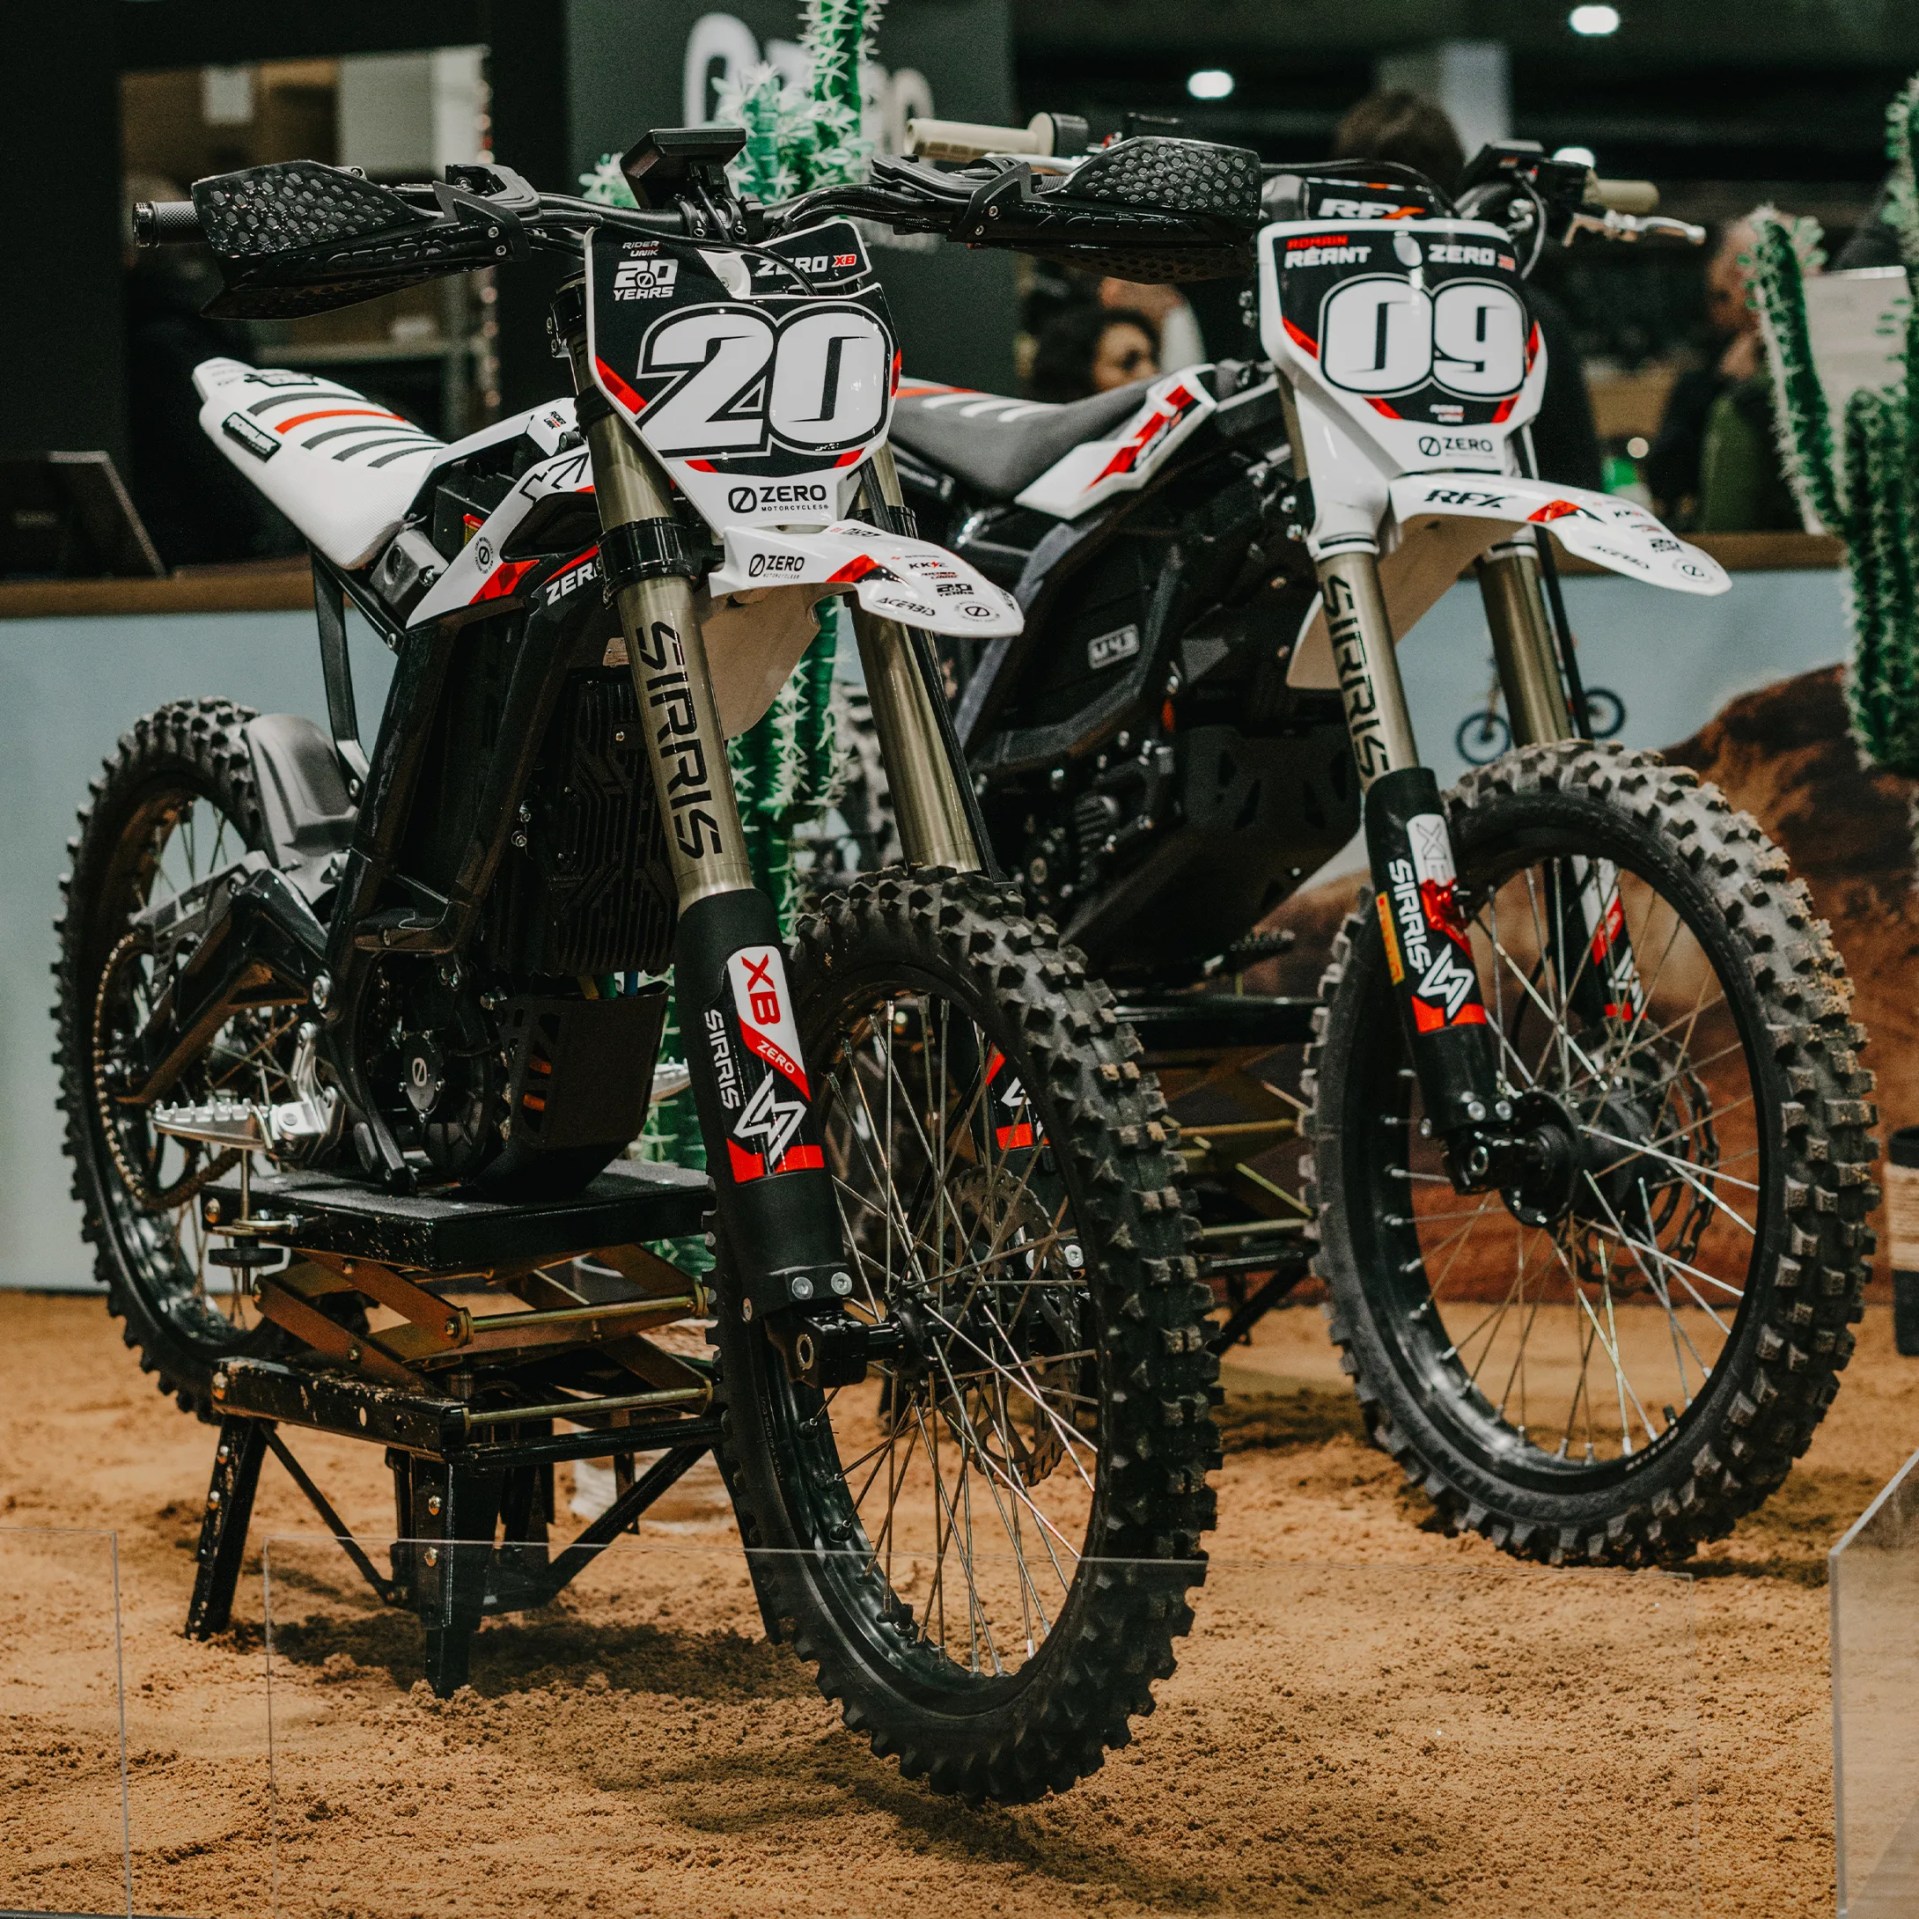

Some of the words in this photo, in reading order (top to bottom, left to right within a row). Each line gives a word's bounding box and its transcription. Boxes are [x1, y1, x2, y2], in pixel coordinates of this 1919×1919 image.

[622, 241, 660, 250] RIDER
[831, 253, 857, 268] XB
[1428, 243, 1496, 267] ZERO
[614, 258, 679, 289] 20
[613, 286, 674, 301] YEARS
[1318, 272, 1531, 402] 09
[637, 302, 893, 457] 20
[1442, 437, 1494, 453] ZERO
[759, 484, 827, 503] ZERO
[766, 554, 806, 572] ZERO
[546, 562, 599, 606] ZER
[1323, 574, 1390, 778] SIRRIS
[637, 620, 724, 860] SIRRIS
[1388, 858, 1432, 975] SIRRIS
[740, 953, 781, 1026] XB
[704, 1008, 741, 1110] SIRRIS
[756, 1040, 795, 1075] ZERO
